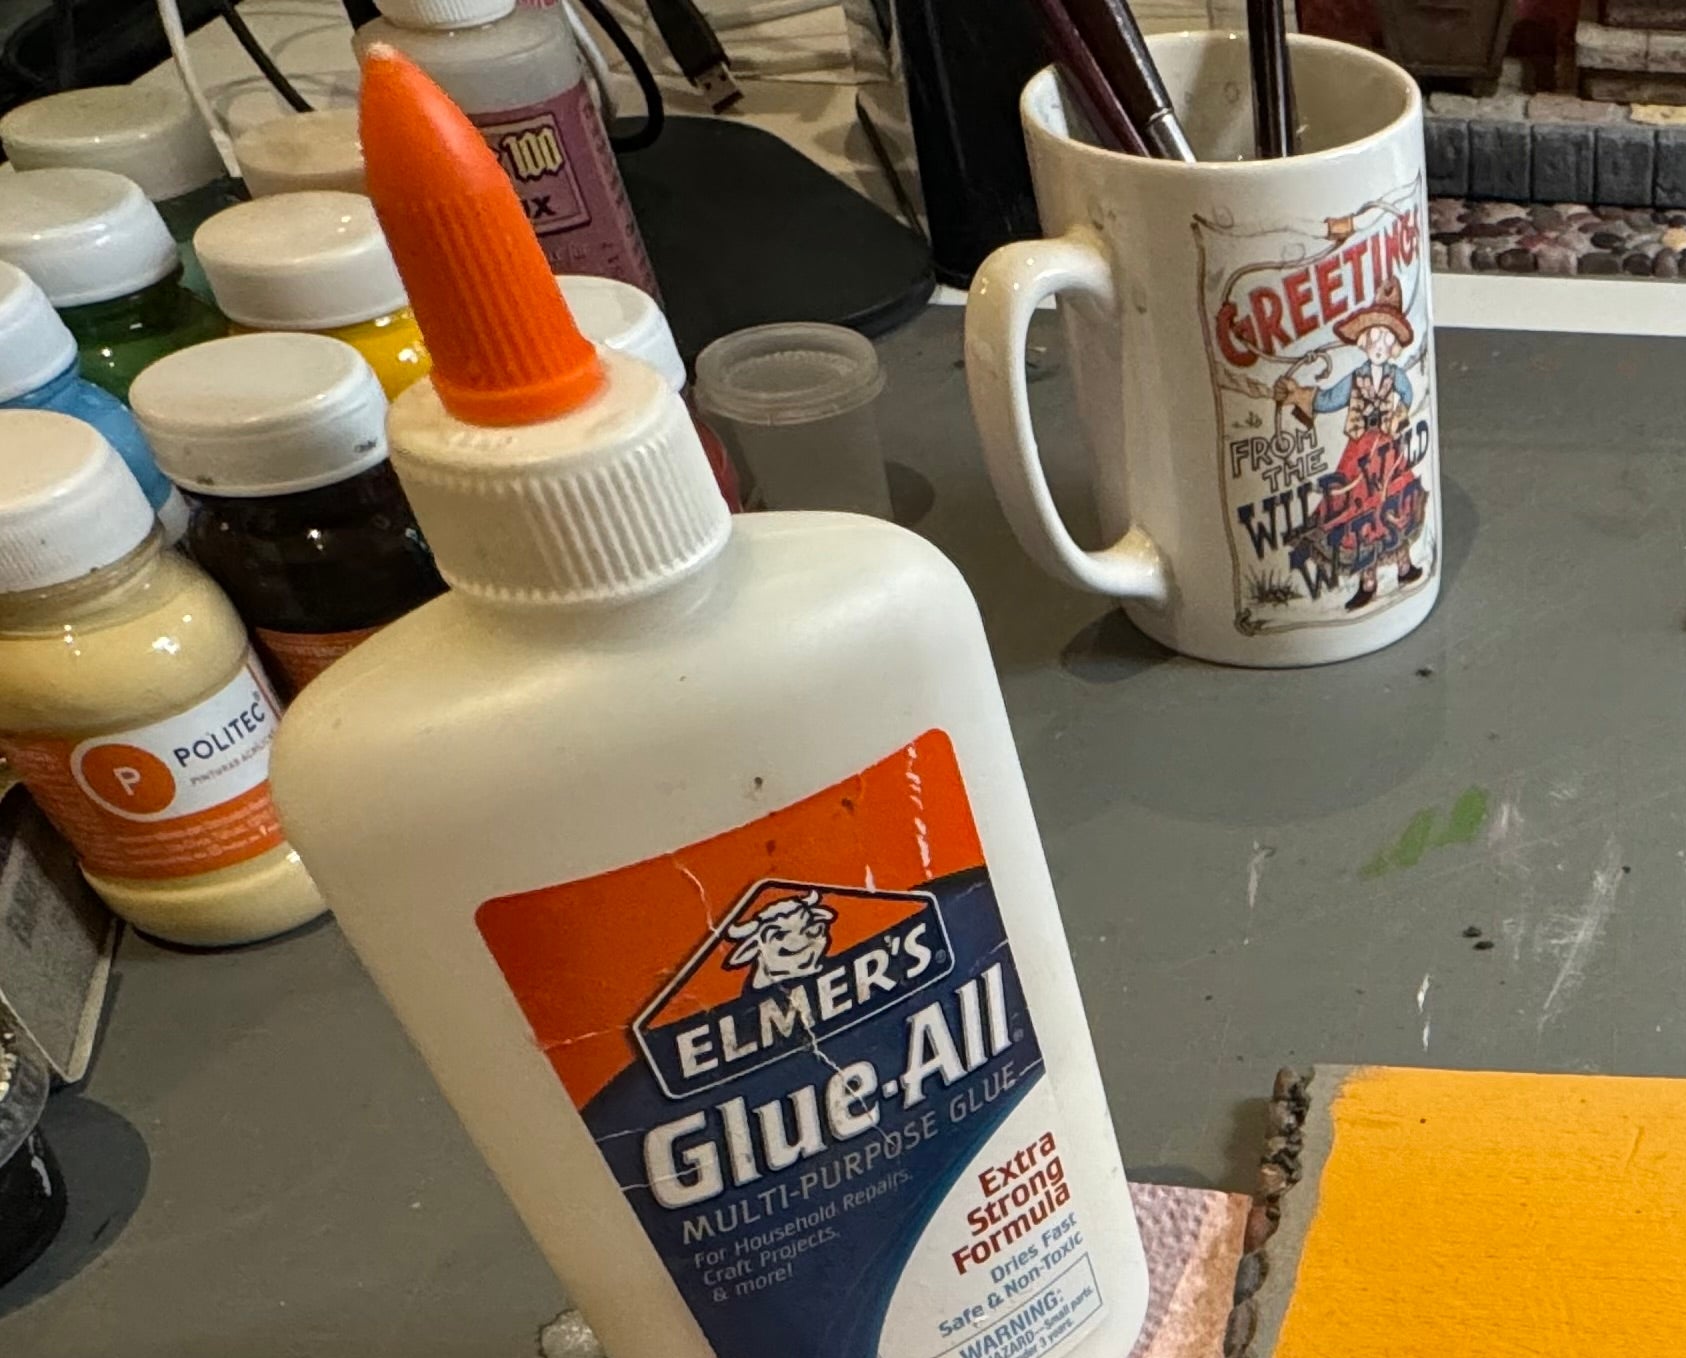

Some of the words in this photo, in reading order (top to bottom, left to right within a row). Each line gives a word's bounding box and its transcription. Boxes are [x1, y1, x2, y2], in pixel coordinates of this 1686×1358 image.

[1230, 428, 1318, 479] FROM
[1263, 447, 1328, 493] THE
[173, 702, 265, 768] POLITEC
[676, 923, 931, 1079] ELMER'S
[682, 1112, 939, 1245] MULTI-PURPOSE
[949, 1062, 1016, 1124] GLUE
[978, 1131, 1056, 1198] Extra
[952, 1182, 1071, 1276] Formula
[967, 1155, 1065, 1236] Strong
[695, 1249, 727, 1269] For
[735, 1202, 837, 1253] Household
[991, 1243, 1039, 1284] Dries
[1041, 1211, 1077, 1248] Fast
[703, 1261, 753, 1286] Craft
[712, 1286, 728, 1301] &
[735, 1263, 794, 1296] more!
[938, 1304, 985, 1338] Safe
[987, 1291, 1005, 1310] &
[1003, 1230, 1084, 1298] Non-Toxic
[1039, 1336, 1048, 1348] 3
